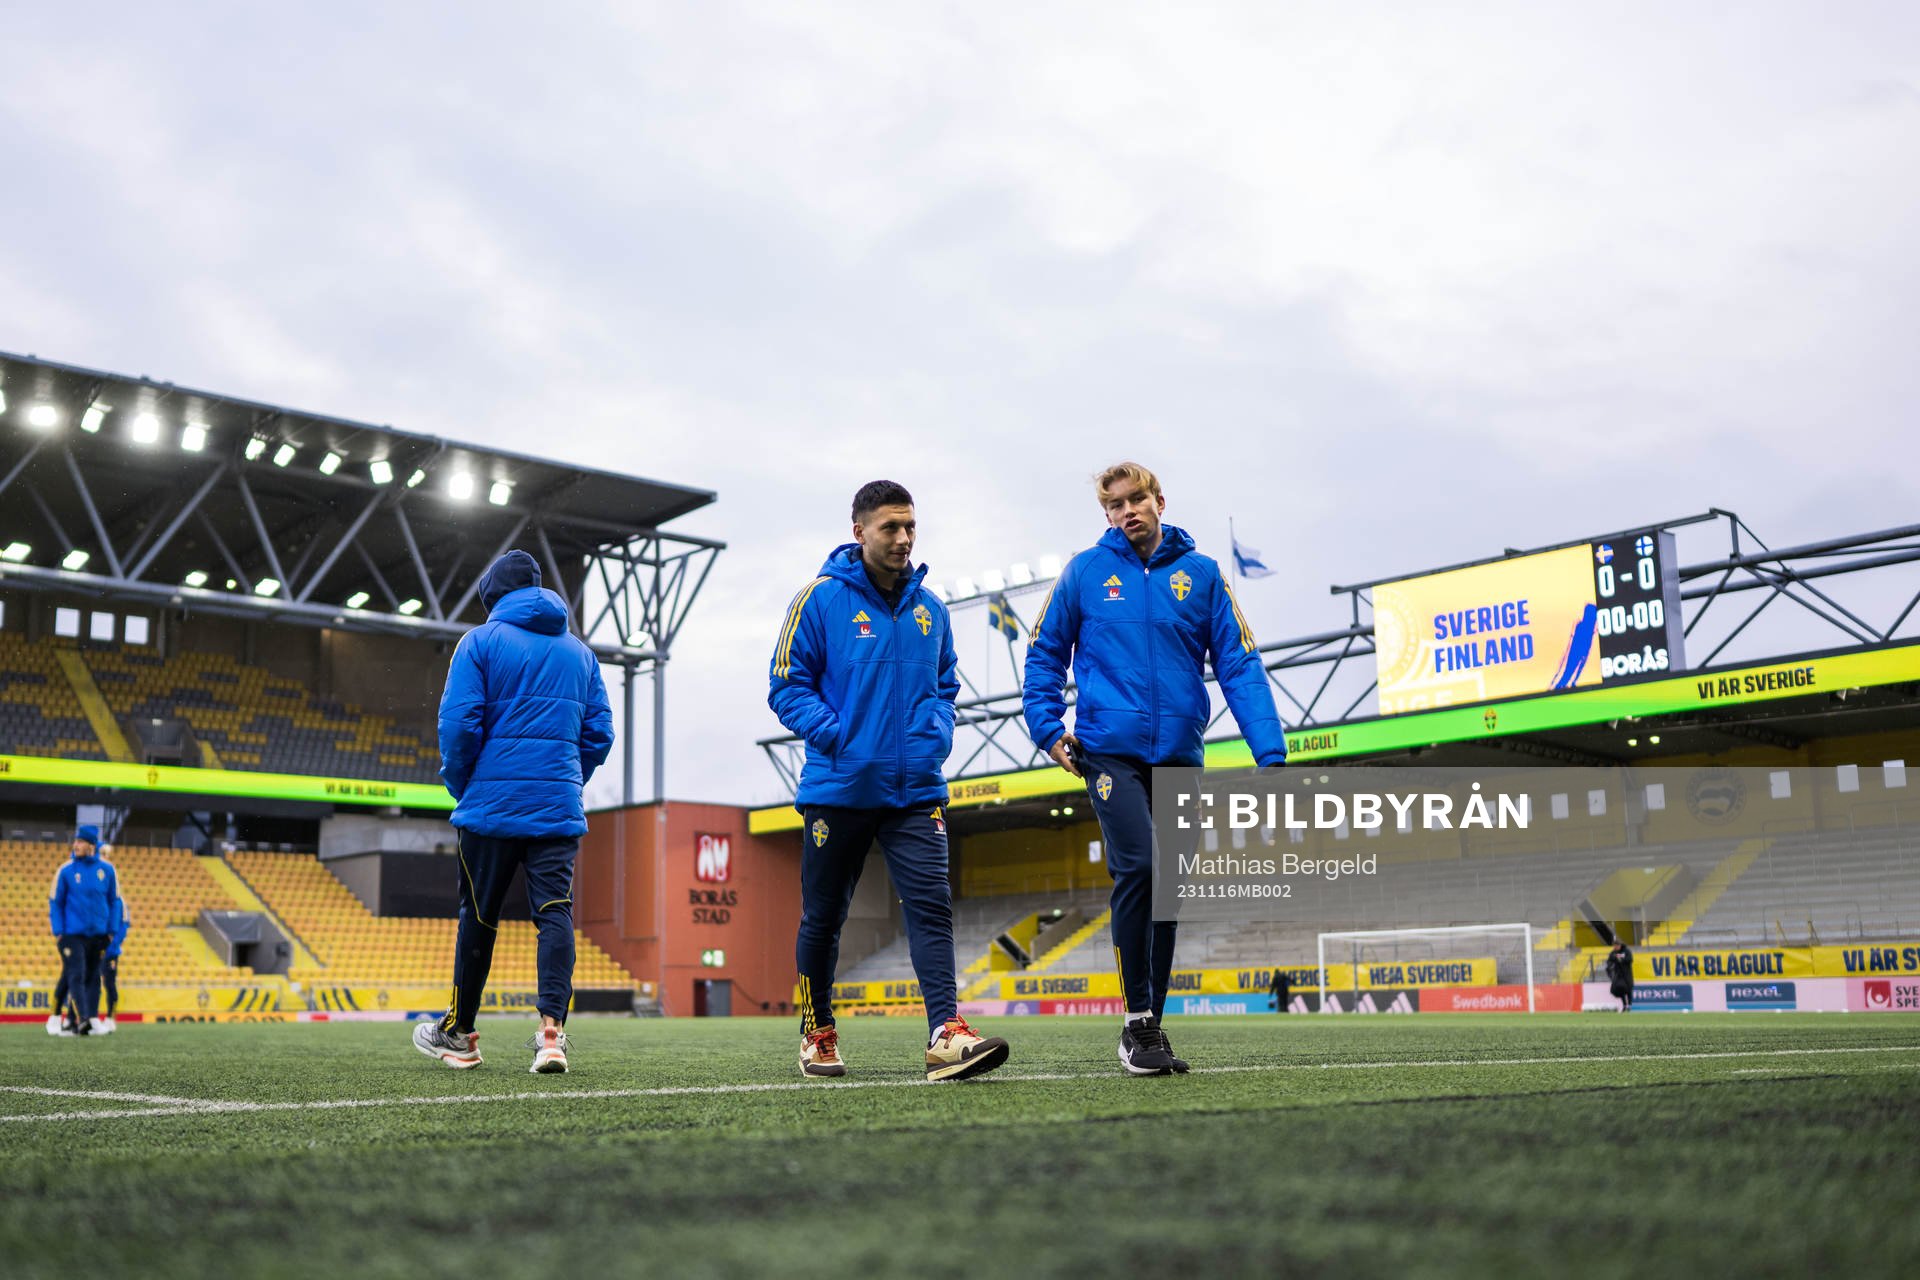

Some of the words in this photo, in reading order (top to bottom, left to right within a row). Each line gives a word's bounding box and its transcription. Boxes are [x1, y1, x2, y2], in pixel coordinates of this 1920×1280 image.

[1598, 565, 1615, 597] 0
[1638, 557, 1655, 590] 0
[1434, 600, 1529, 640] SVERIGE
[1434, 634, 1533, 673] FINLAND
[1601, 645, 1669, 678] BORÅS
[1697, 681, 1713, 699] VI
[1744, 667, 1816, 693] SVERIGE
[693, 908, 730, 925] STAD
[1652, 957, 1671, 976] VI
[1842, 950, 1865, 972] VI
[1870, 948, 1899, 971] ÄR
[1238, 971, 1249, 989] VI
[1370, 966, 1404, 985] HEJA
[1408, 963, 1472, 984] SVERIGE!
[1452, 993, 1522, 1009] Swedbank
